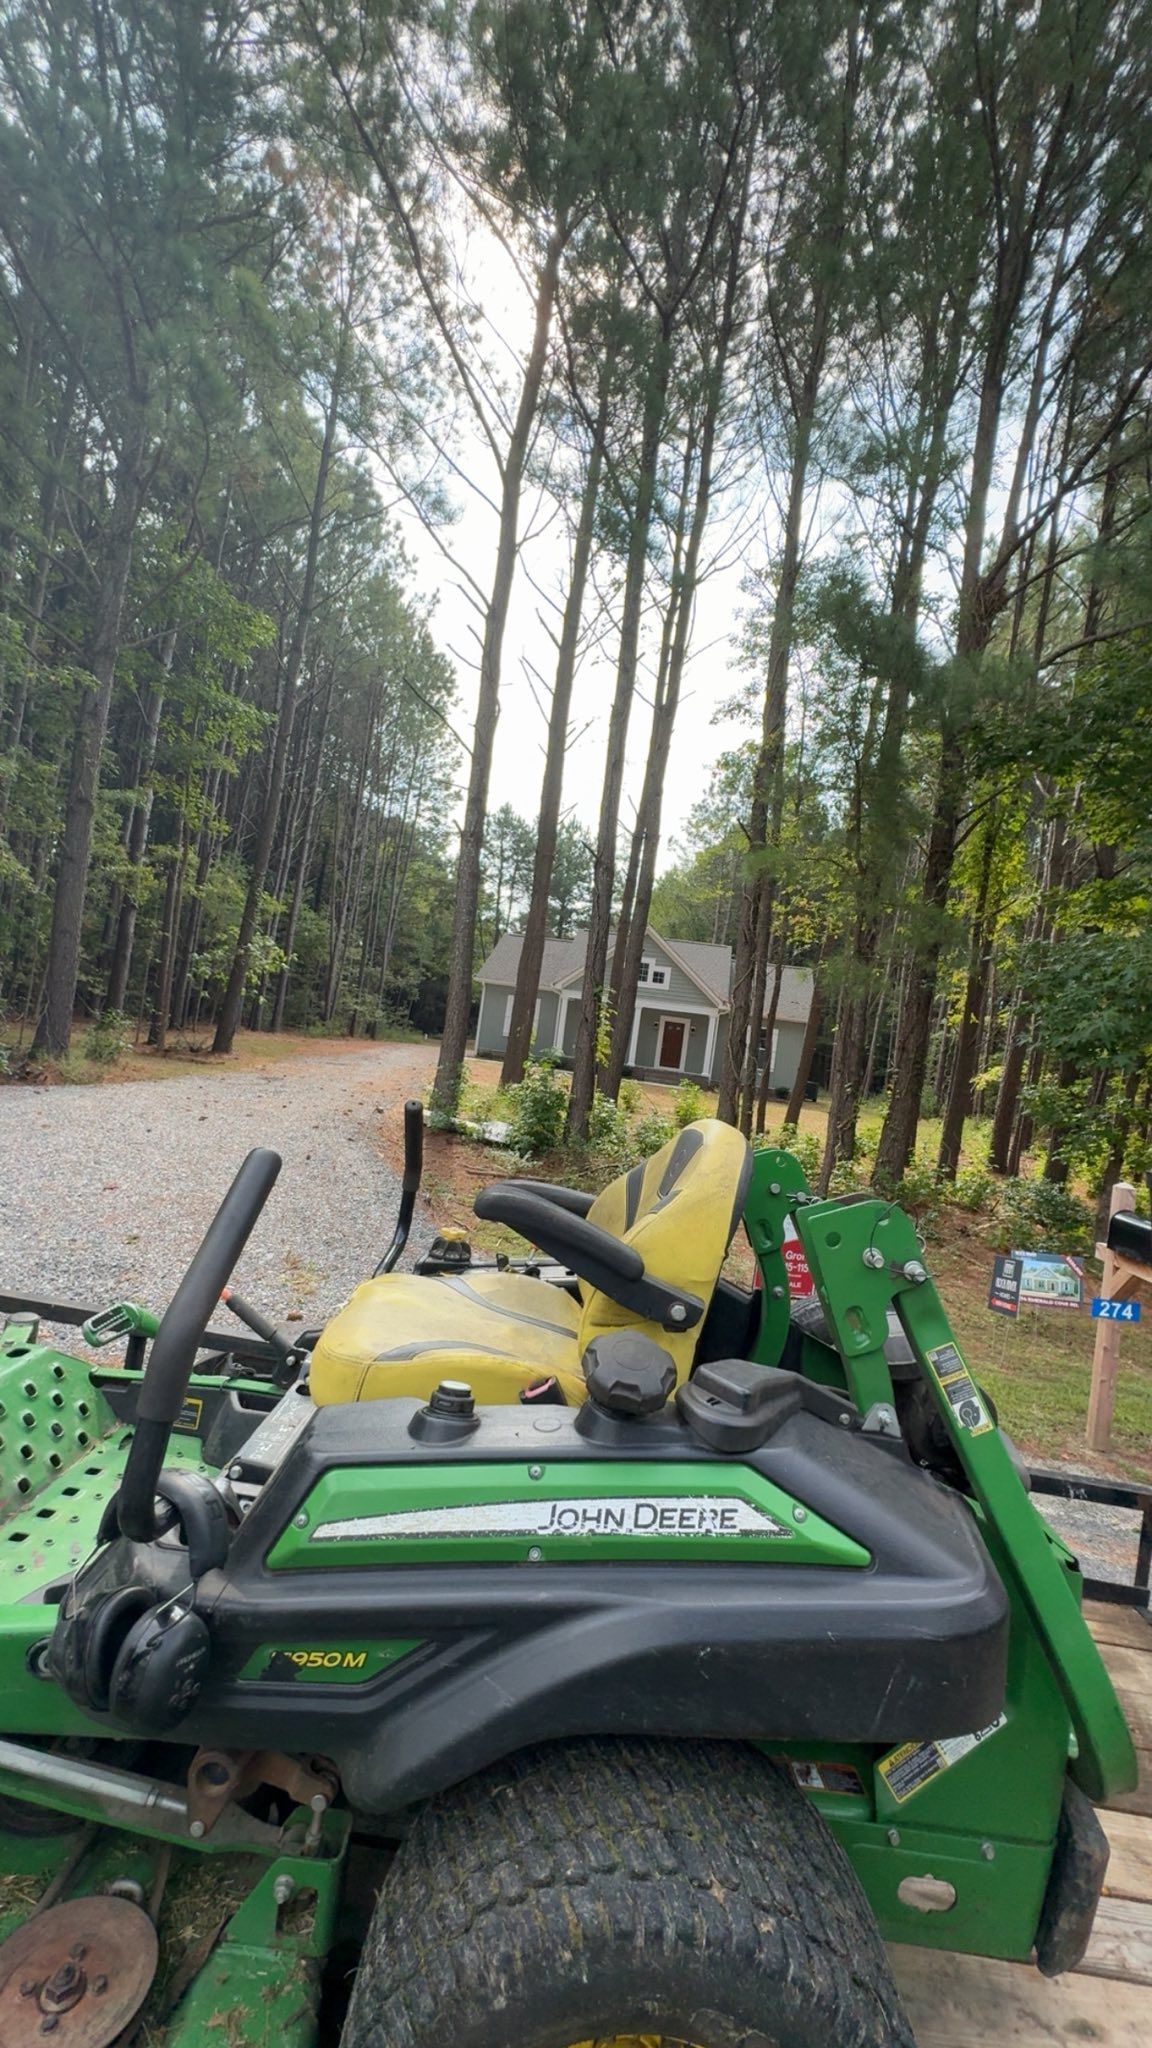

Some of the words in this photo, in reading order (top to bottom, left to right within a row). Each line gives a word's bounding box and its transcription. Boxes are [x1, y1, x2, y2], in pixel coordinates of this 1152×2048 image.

[1099, 1301, 1133, 1320] 274
[537, 1503, 625, 1531] JOHN
[633, 1503, 739, 1530] DEERE
[271, 1651, 366, 1668] 950M
